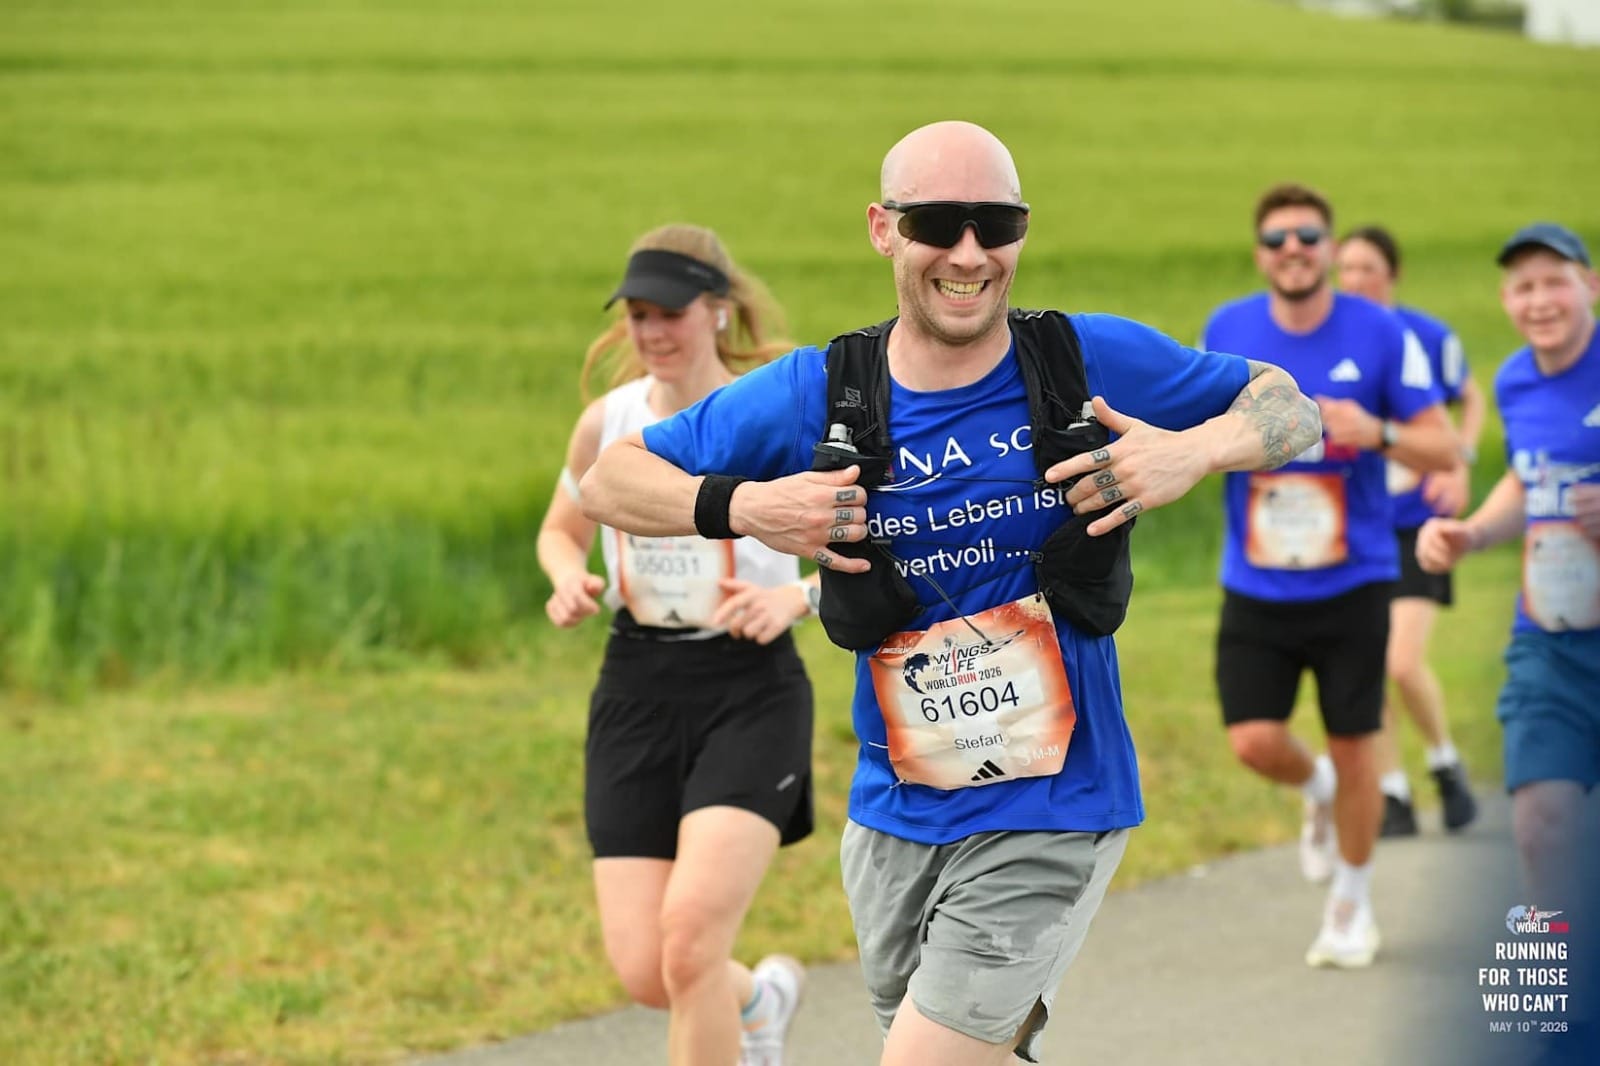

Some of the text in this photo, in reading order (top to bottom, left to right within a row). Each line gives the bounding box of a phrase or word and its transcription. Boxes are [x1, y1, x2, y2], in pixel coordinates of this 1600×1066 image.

[899, 425, 1033, 476] NA SC
[868, 486, 1065, 538] des Leben ist
[932, 643, 991, 666] WINGS
[944, 657, 976, 676] LIFE
[978, 666, 1002, 681] 2026
[920, 681, 1020, 723] 61604
[954, 733, 1004, 751] Stefan
